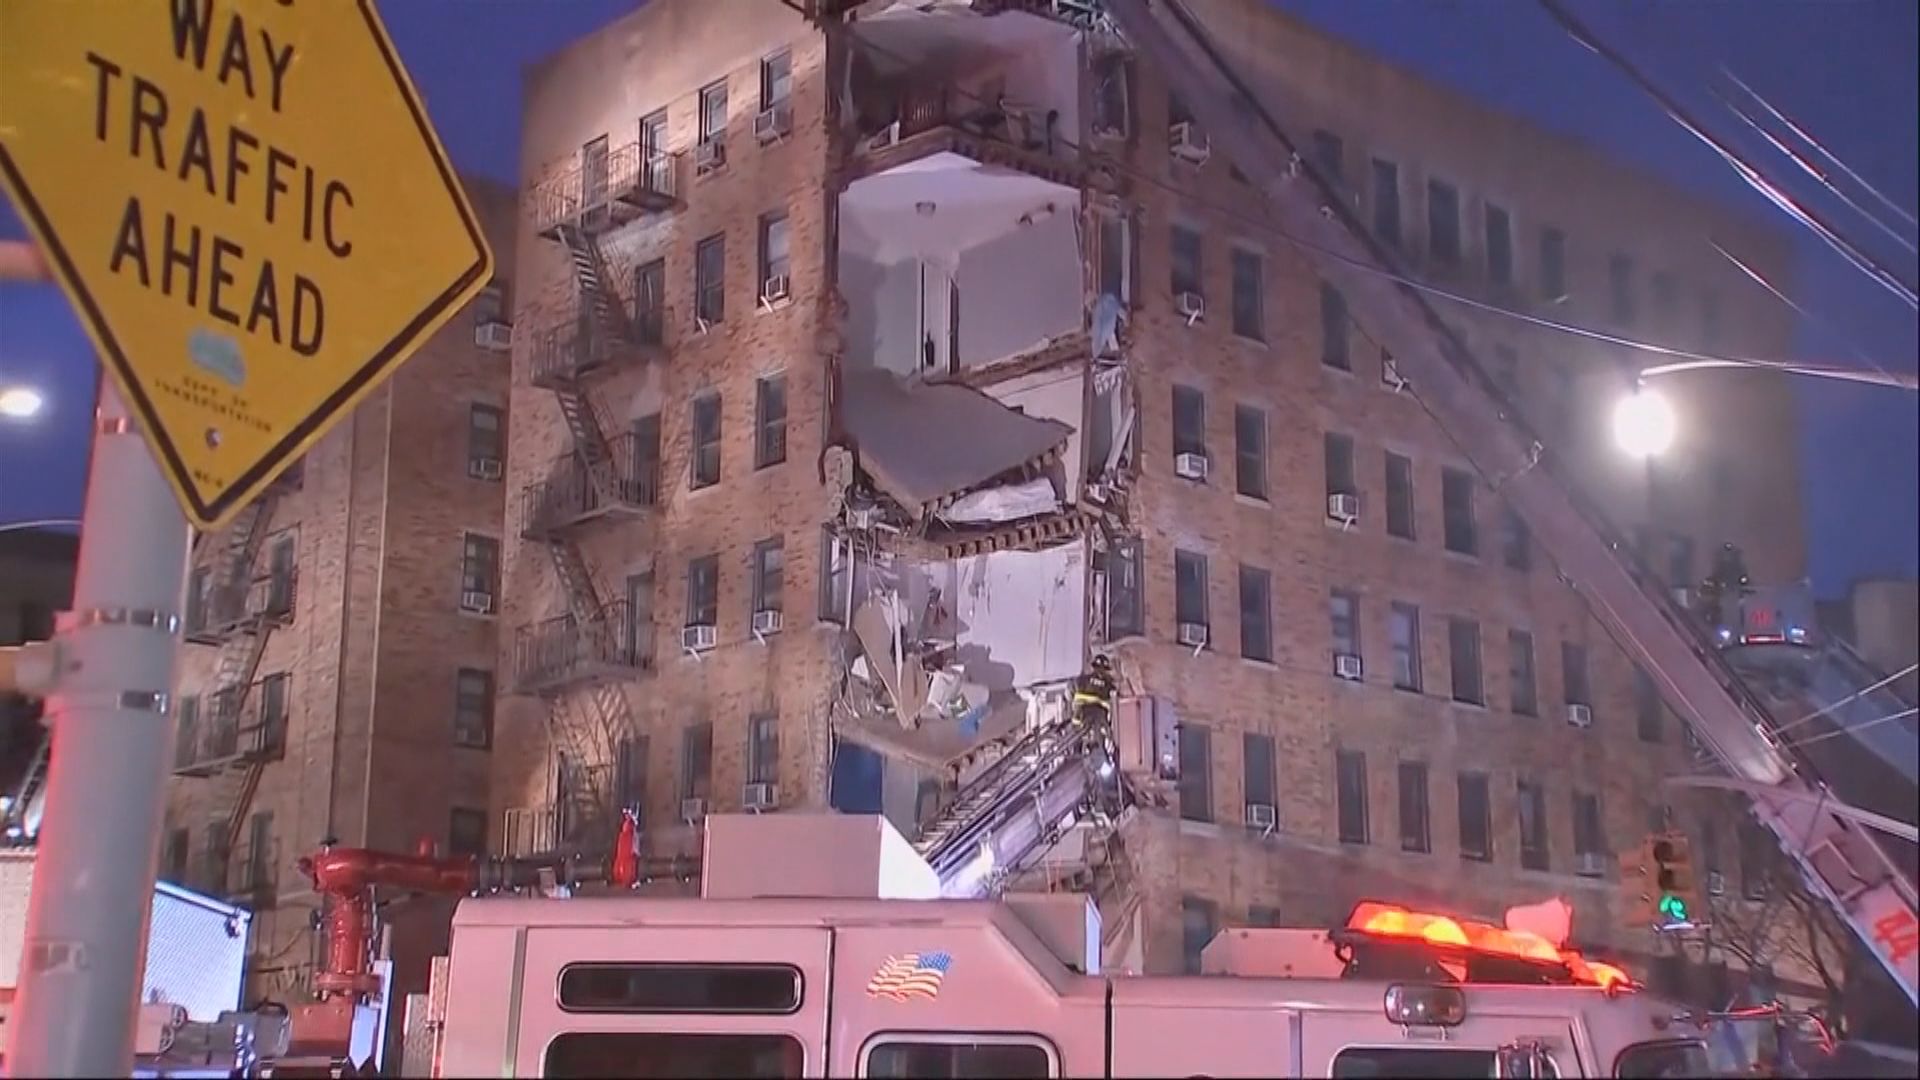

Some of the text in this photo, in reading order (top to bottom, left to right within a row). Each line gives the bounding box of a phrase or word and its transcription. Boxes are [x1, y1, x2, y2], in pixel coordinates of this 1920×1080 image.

[170, 0, 295, 113] WAY
[86, 50, 355, 259] TRAFFIC
[109, 195, 325, 358] AHEAD
